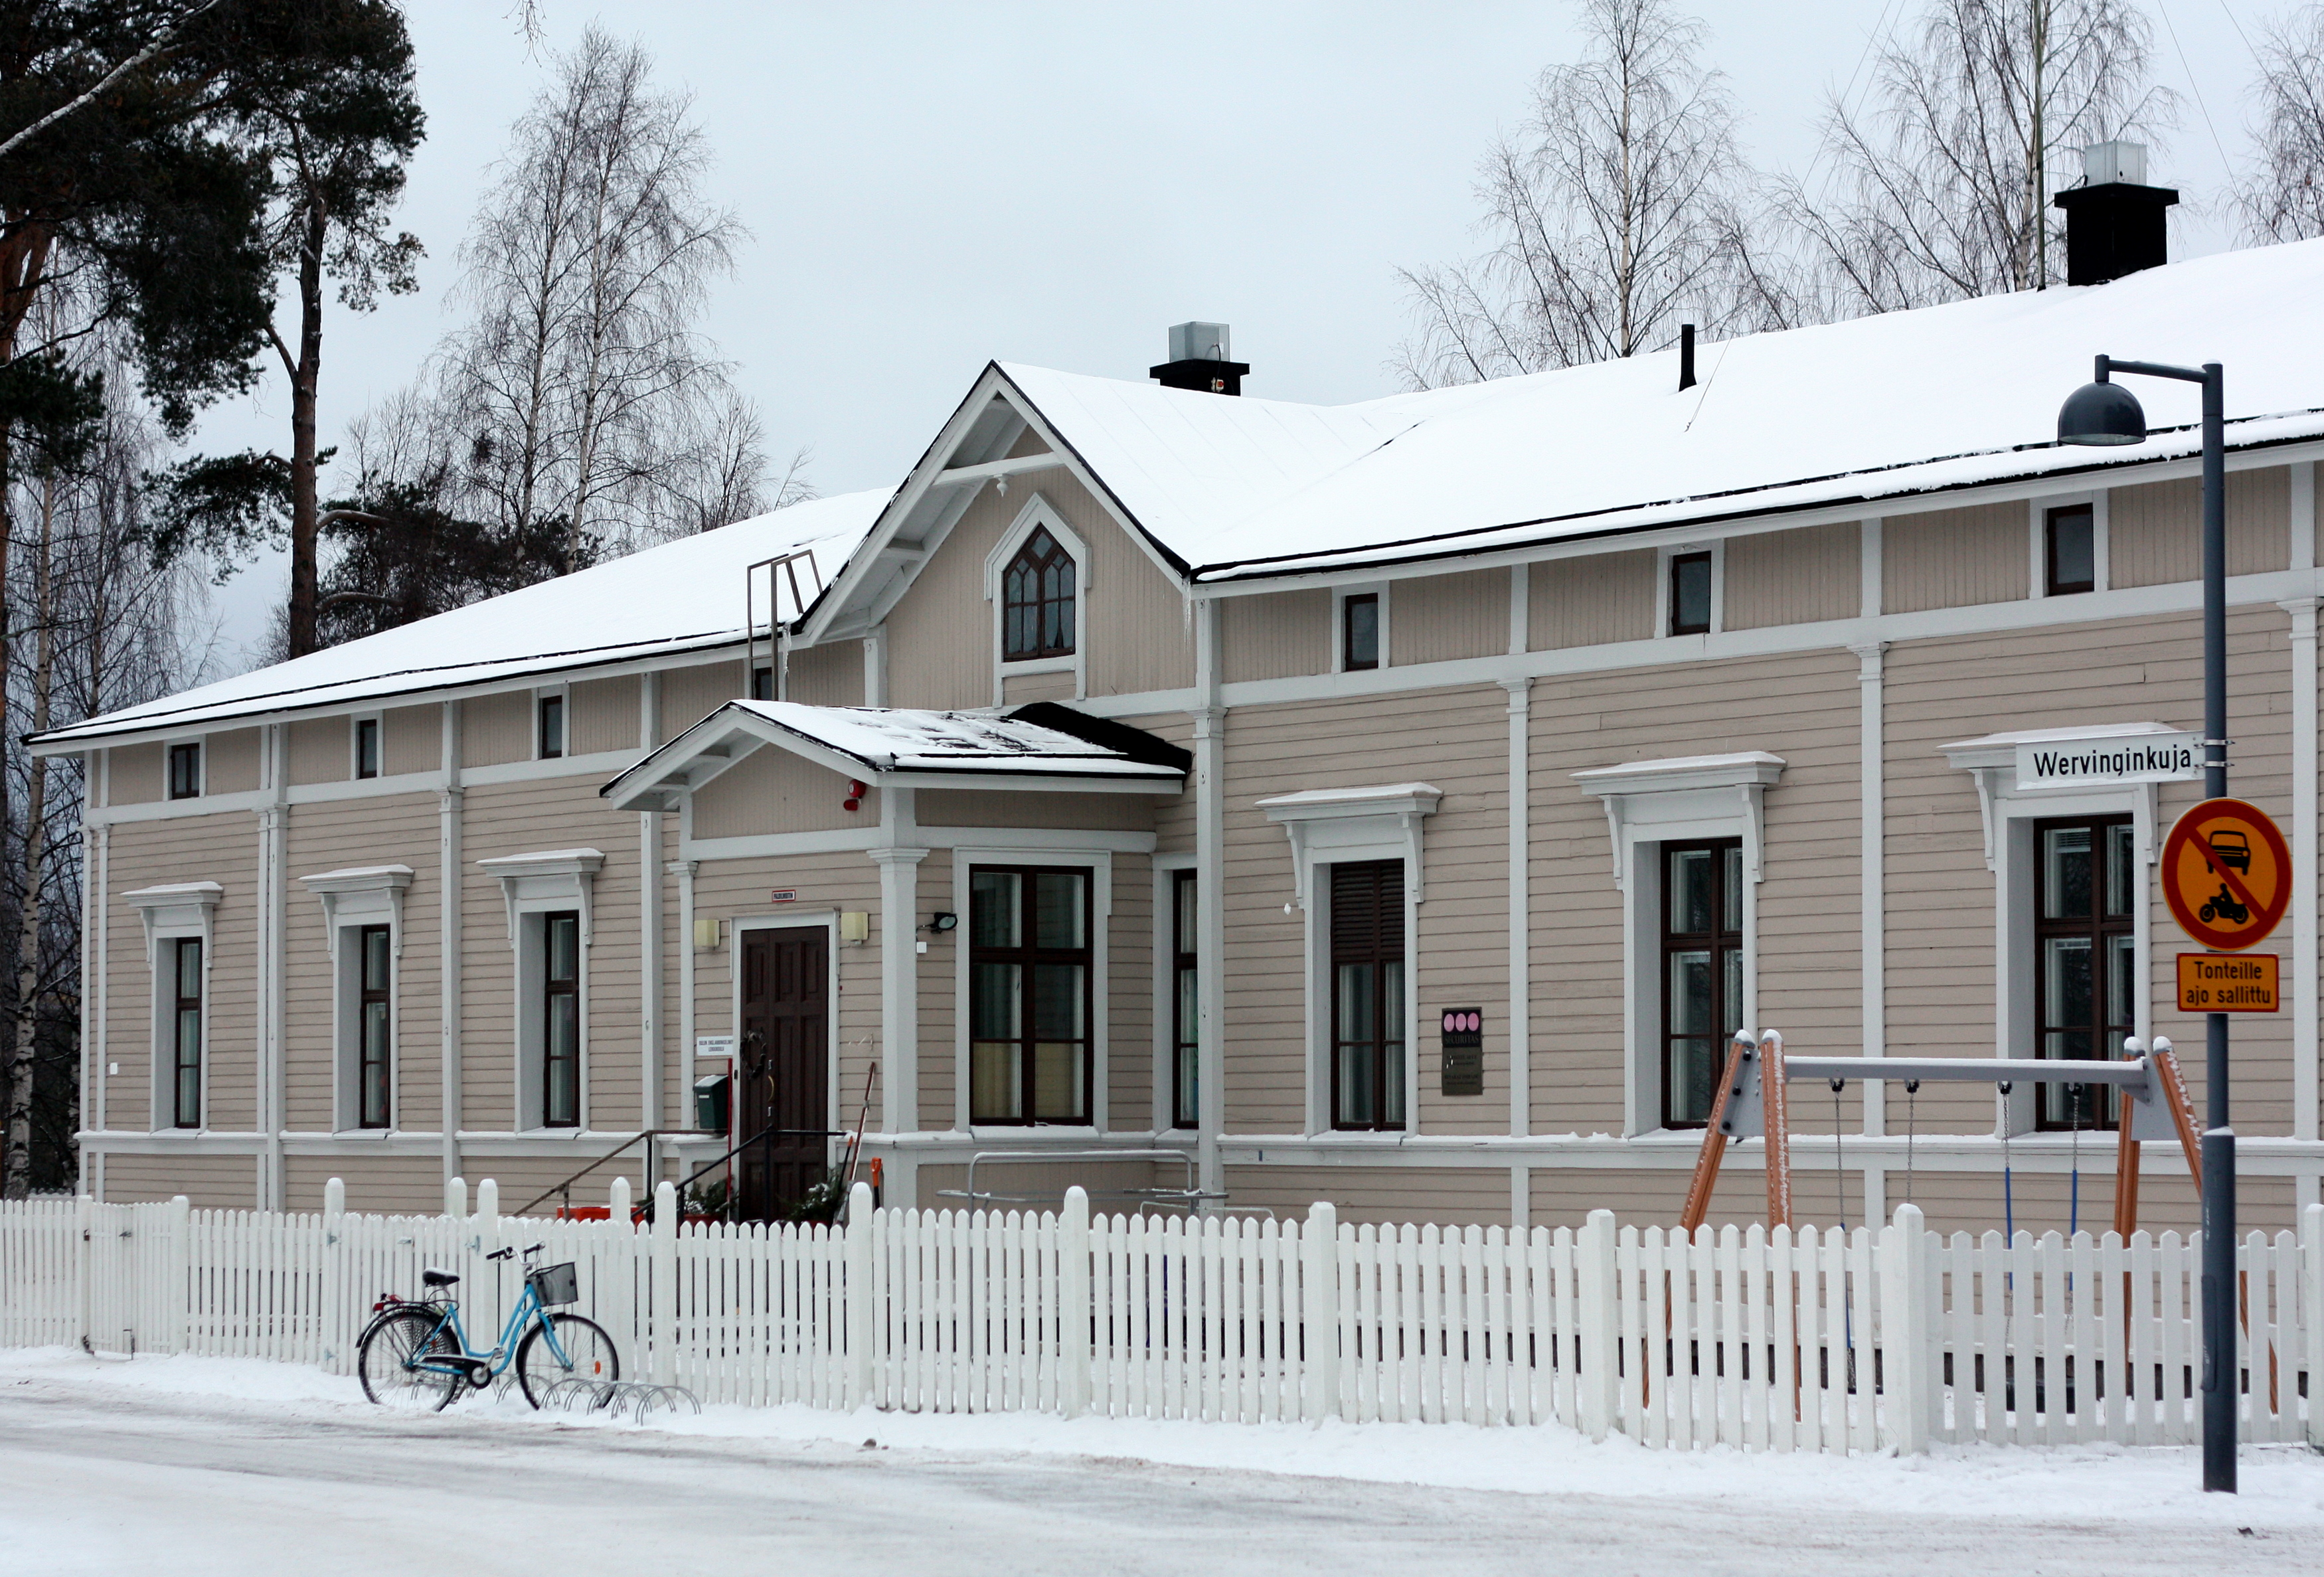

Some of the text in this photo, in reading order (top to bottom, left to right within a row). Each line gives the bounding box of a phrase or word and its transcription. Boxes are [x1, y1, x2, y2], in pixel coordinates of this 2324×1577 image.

[2034, 744, 2191, 777] Wervinginkuja
[2195, 961, 2262, 979] Tonteille
[2187, 985, 2271, 1006] ajo sallittu
[1445, 1035, 1479, 1044] SECURITAS
